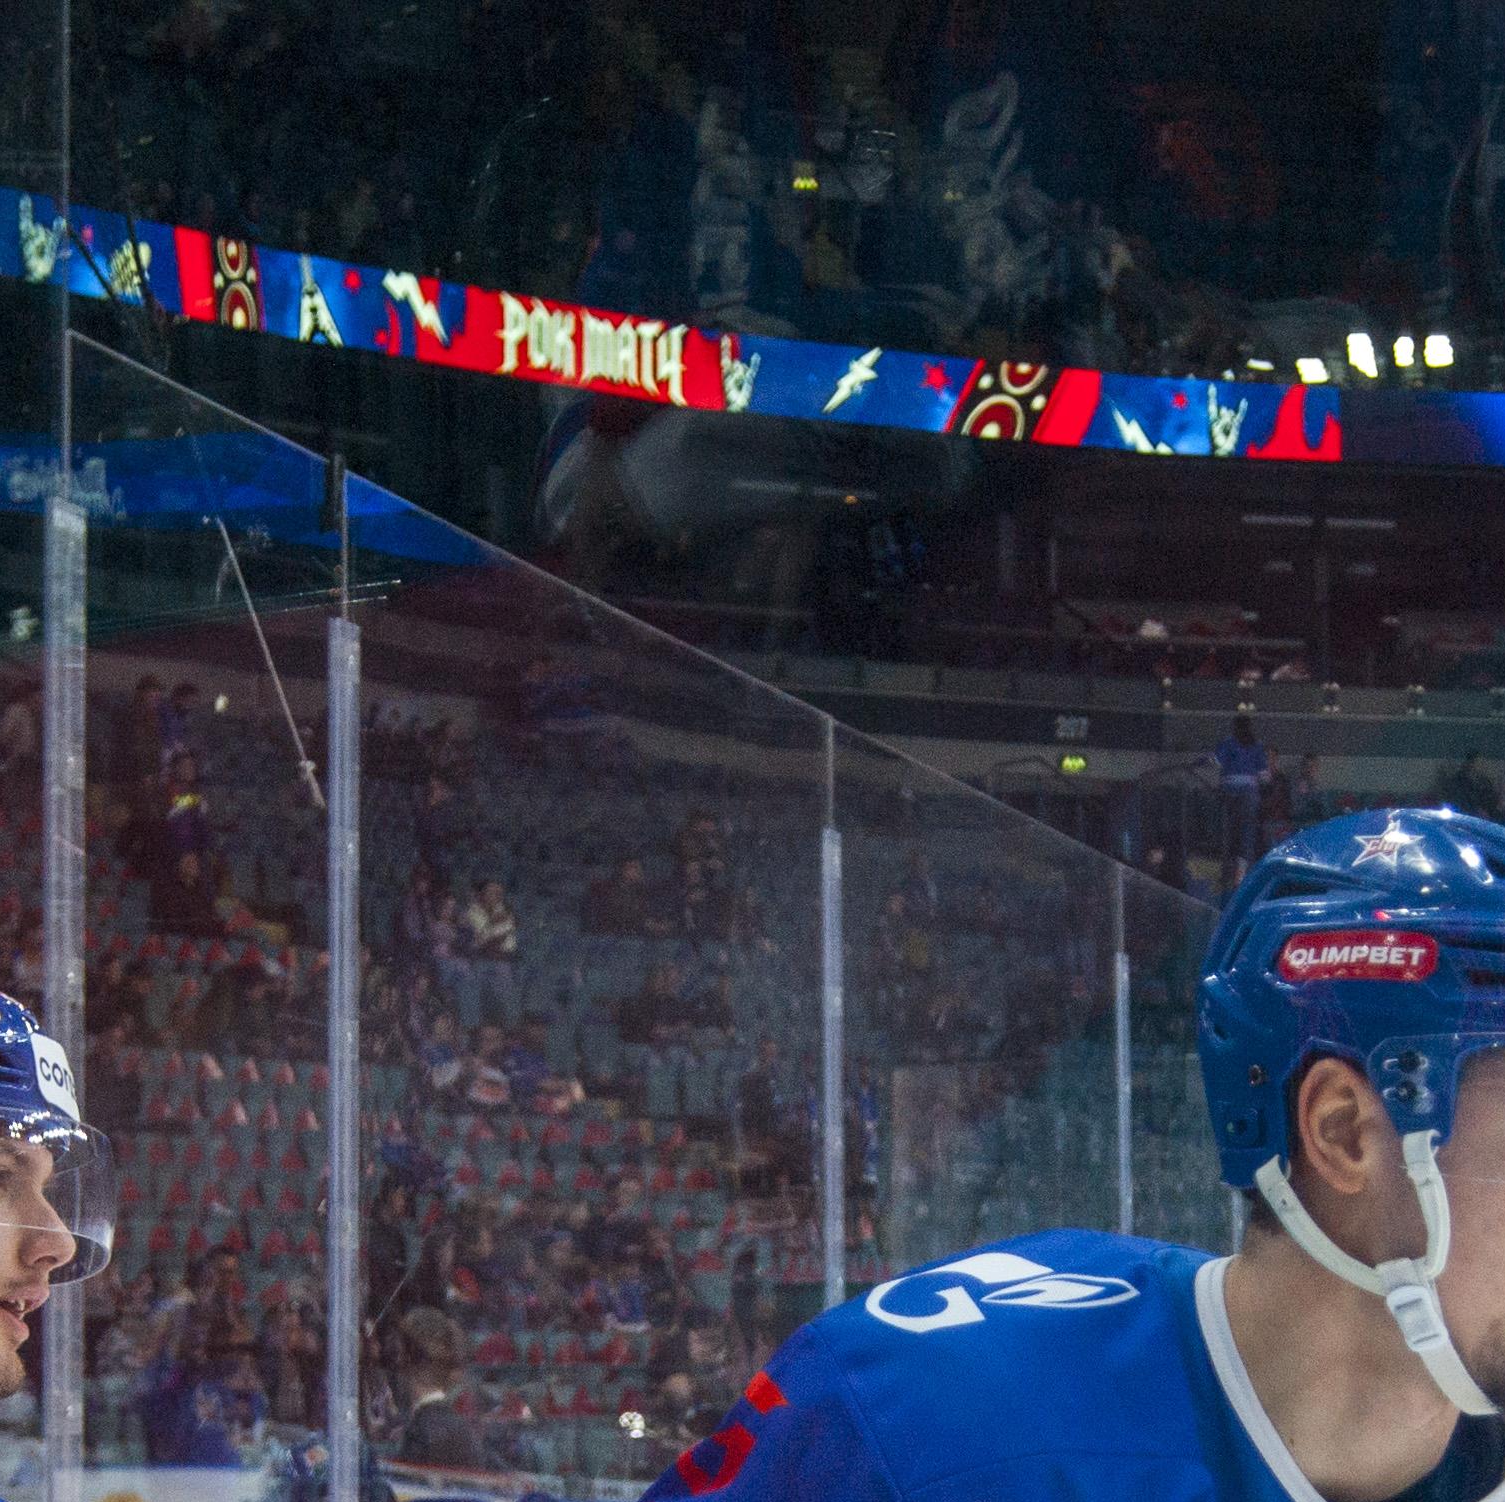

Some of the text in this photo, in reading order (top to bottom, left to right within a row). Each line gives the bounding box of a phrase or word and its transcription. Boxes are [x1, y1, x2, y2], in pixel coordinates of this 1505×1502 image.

[495, 291, 688, 407] РОК МАТЧ
[1289, 945, 1426, 967] OLIMPBET
